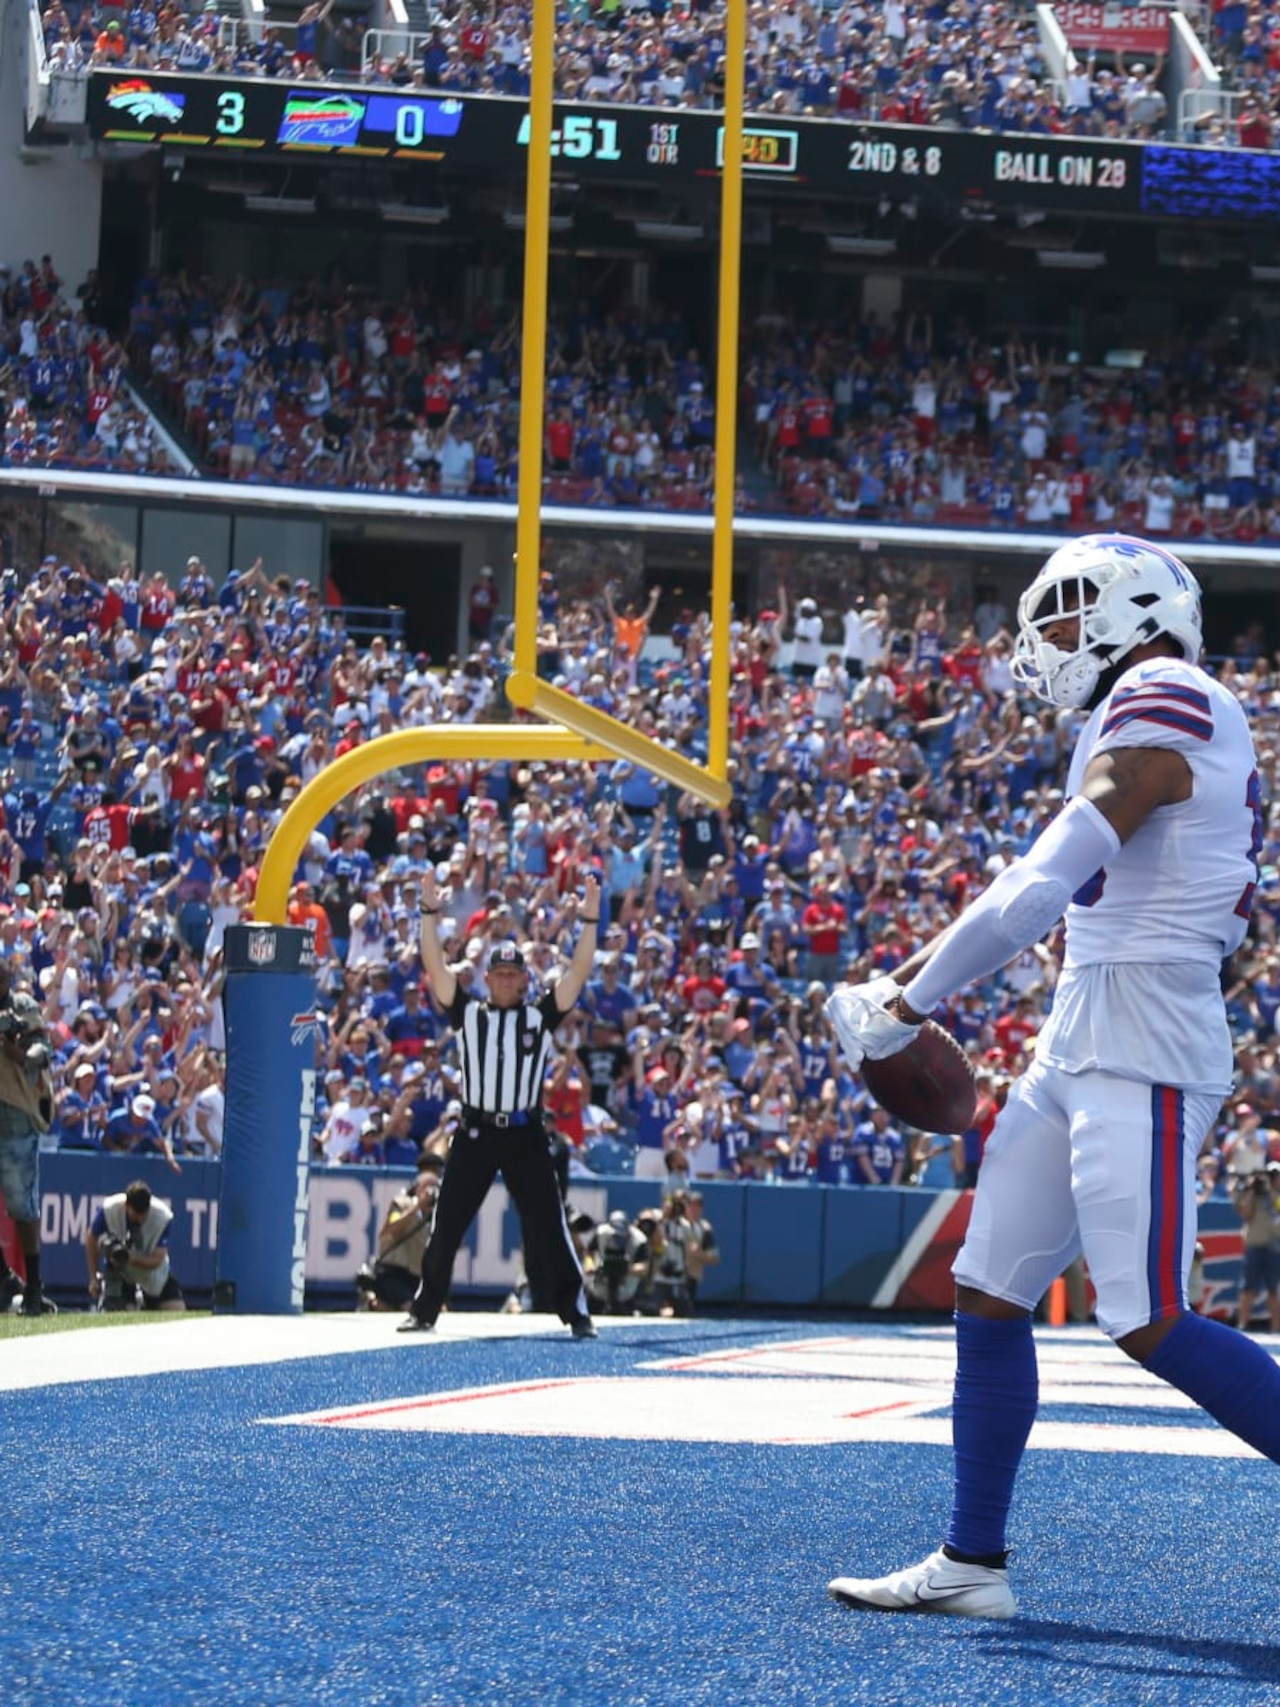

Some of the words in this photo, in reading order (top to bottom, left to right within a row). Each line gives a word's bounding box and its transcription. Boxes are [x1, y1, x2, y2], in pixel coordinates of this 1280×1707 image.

[216, 91, 244, 134] 3
[396, 105, 424, 146] 0
[651, 123, 679, 143] 1ST
[848, 141, 896, 170] 2ND
[902, 147, 924, 174] &
[926, 149, 941, 175] 8
[996, 150, 1053, 183] BALL
[1059, 156, 1091, 183] ON
[1097, 159, 1126, 187] 28
[150, 597, 167, 614] 14
[276, 667, 291, 686] 17
[15, 818, 36, 838] 17
[89, 818, 111, 842] 25
[805, 1055, 826, 1078] 17
